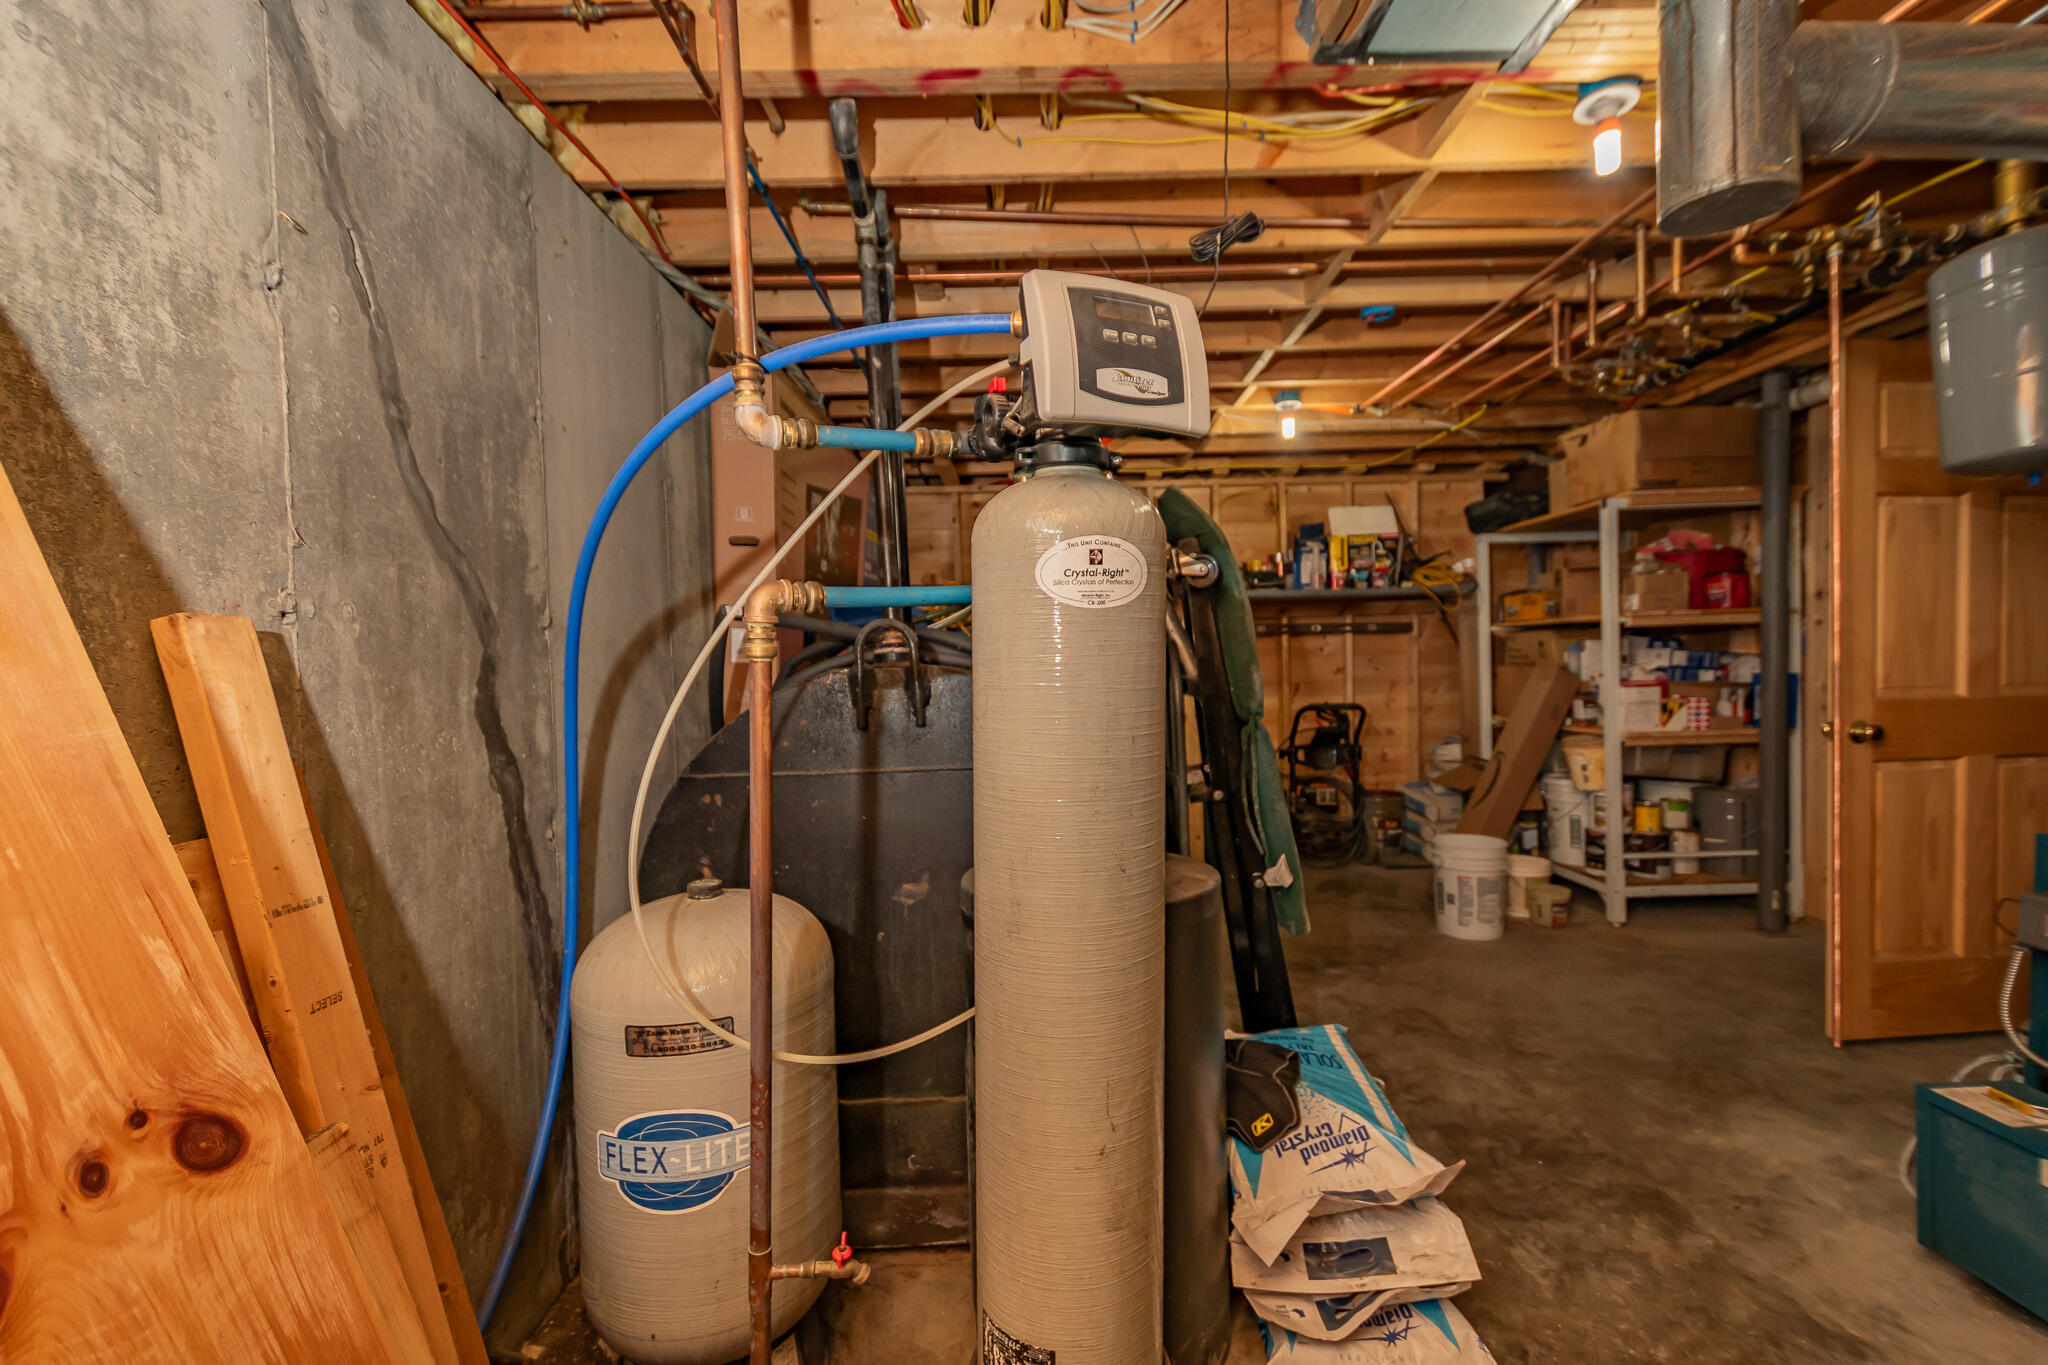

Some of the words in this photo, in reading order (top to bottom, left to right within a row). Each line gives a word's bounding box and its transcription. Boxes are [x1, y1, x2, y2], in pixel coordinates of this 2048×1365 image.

[1071, 579, 1096, 587] Crystals
[310, 990, 343, 1015] SELECT
[1274, 1122, 1334, 1158] Crystal
[1299, 1125, 1371, 1166] Diamond
